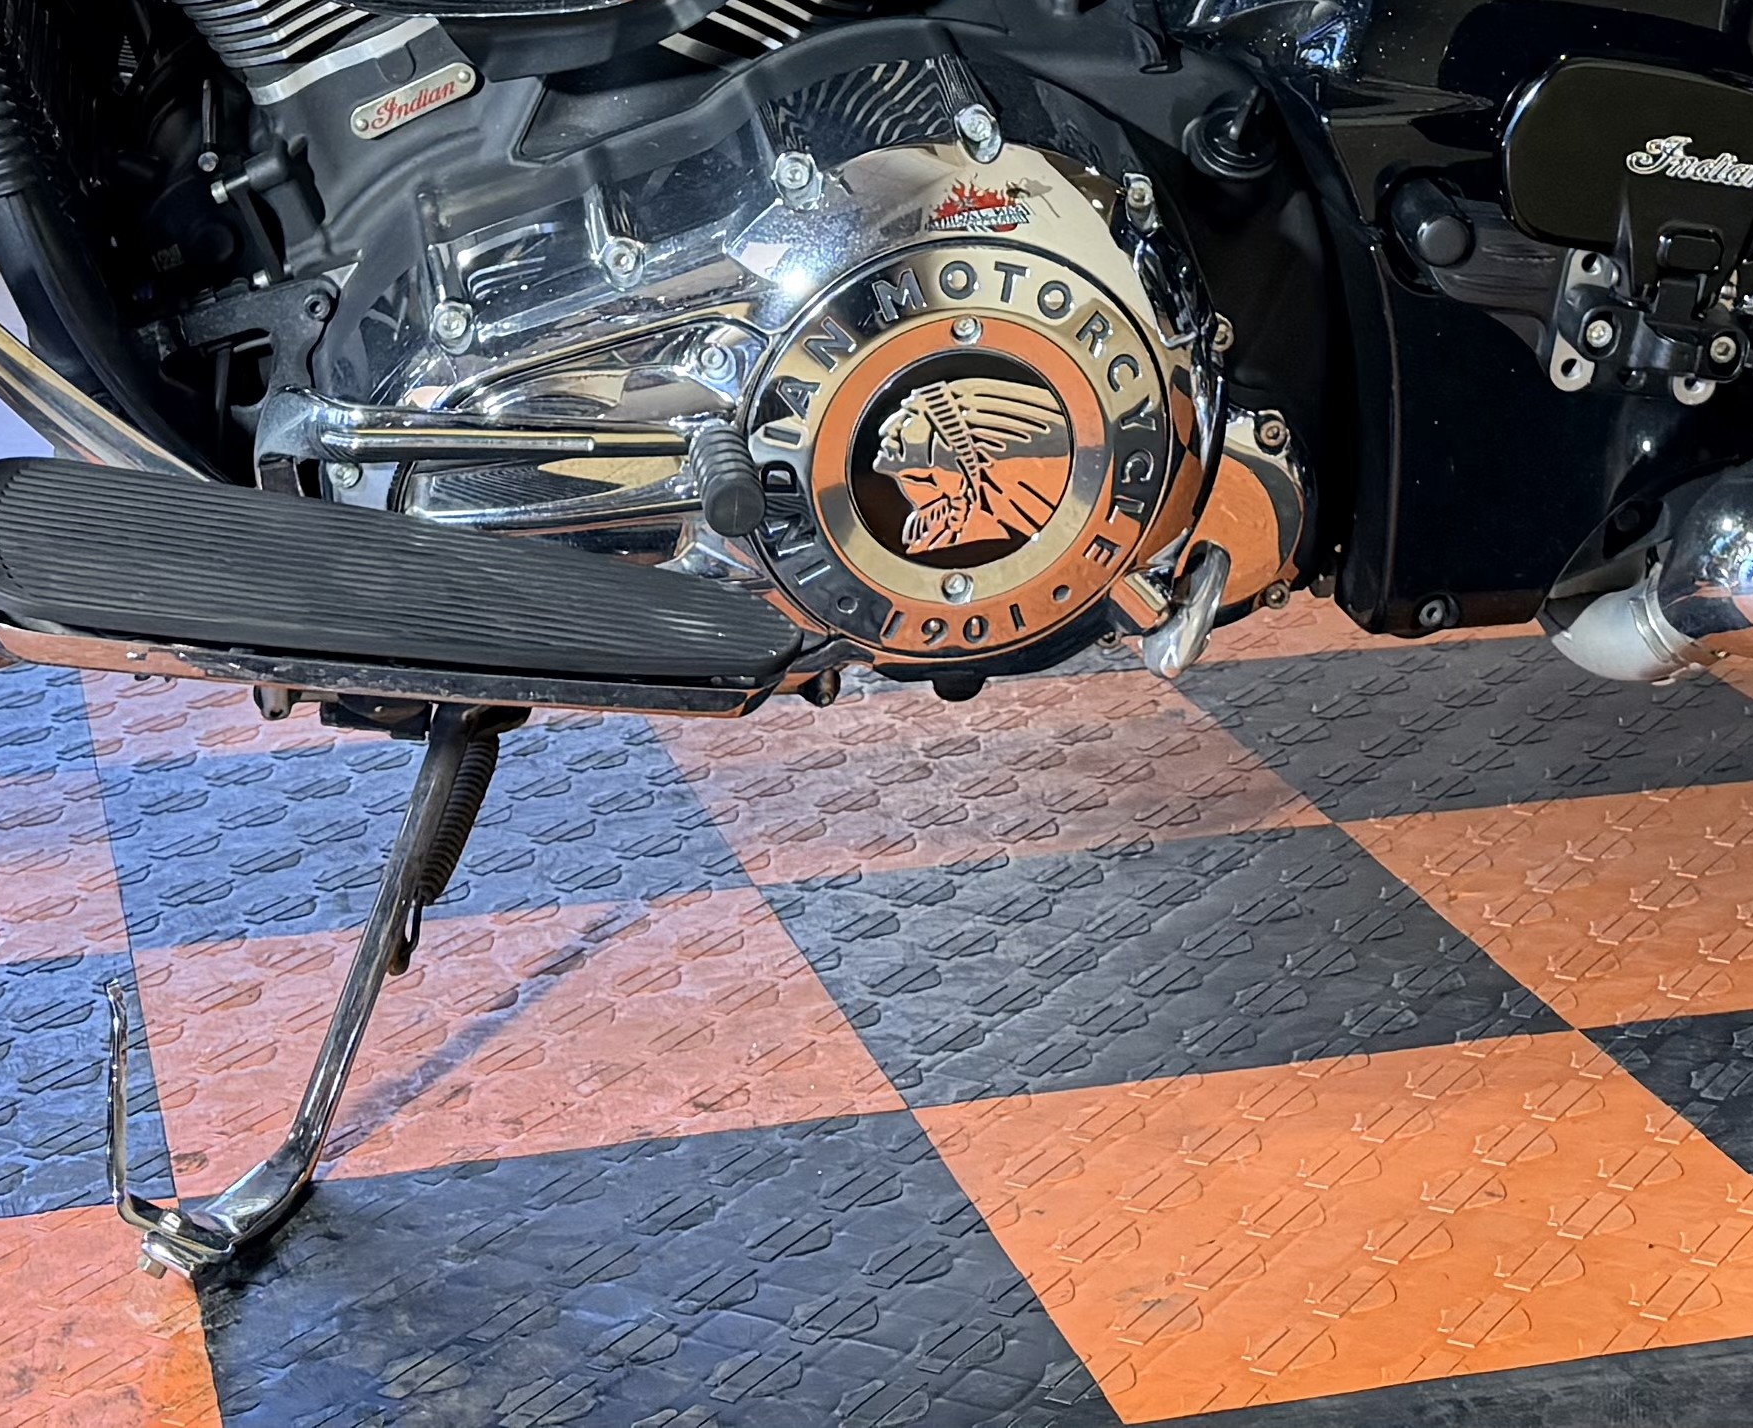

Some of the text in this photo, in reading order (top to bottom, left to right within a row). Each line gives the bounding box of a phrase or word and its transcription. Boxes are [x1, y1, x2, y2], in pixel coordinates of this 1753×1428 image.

[371, 80, 456, 129] Indian
[760, 256, 1161, 588] INDIAN MOTORCYCLE
[880, 602, 1028, 647] 1901
